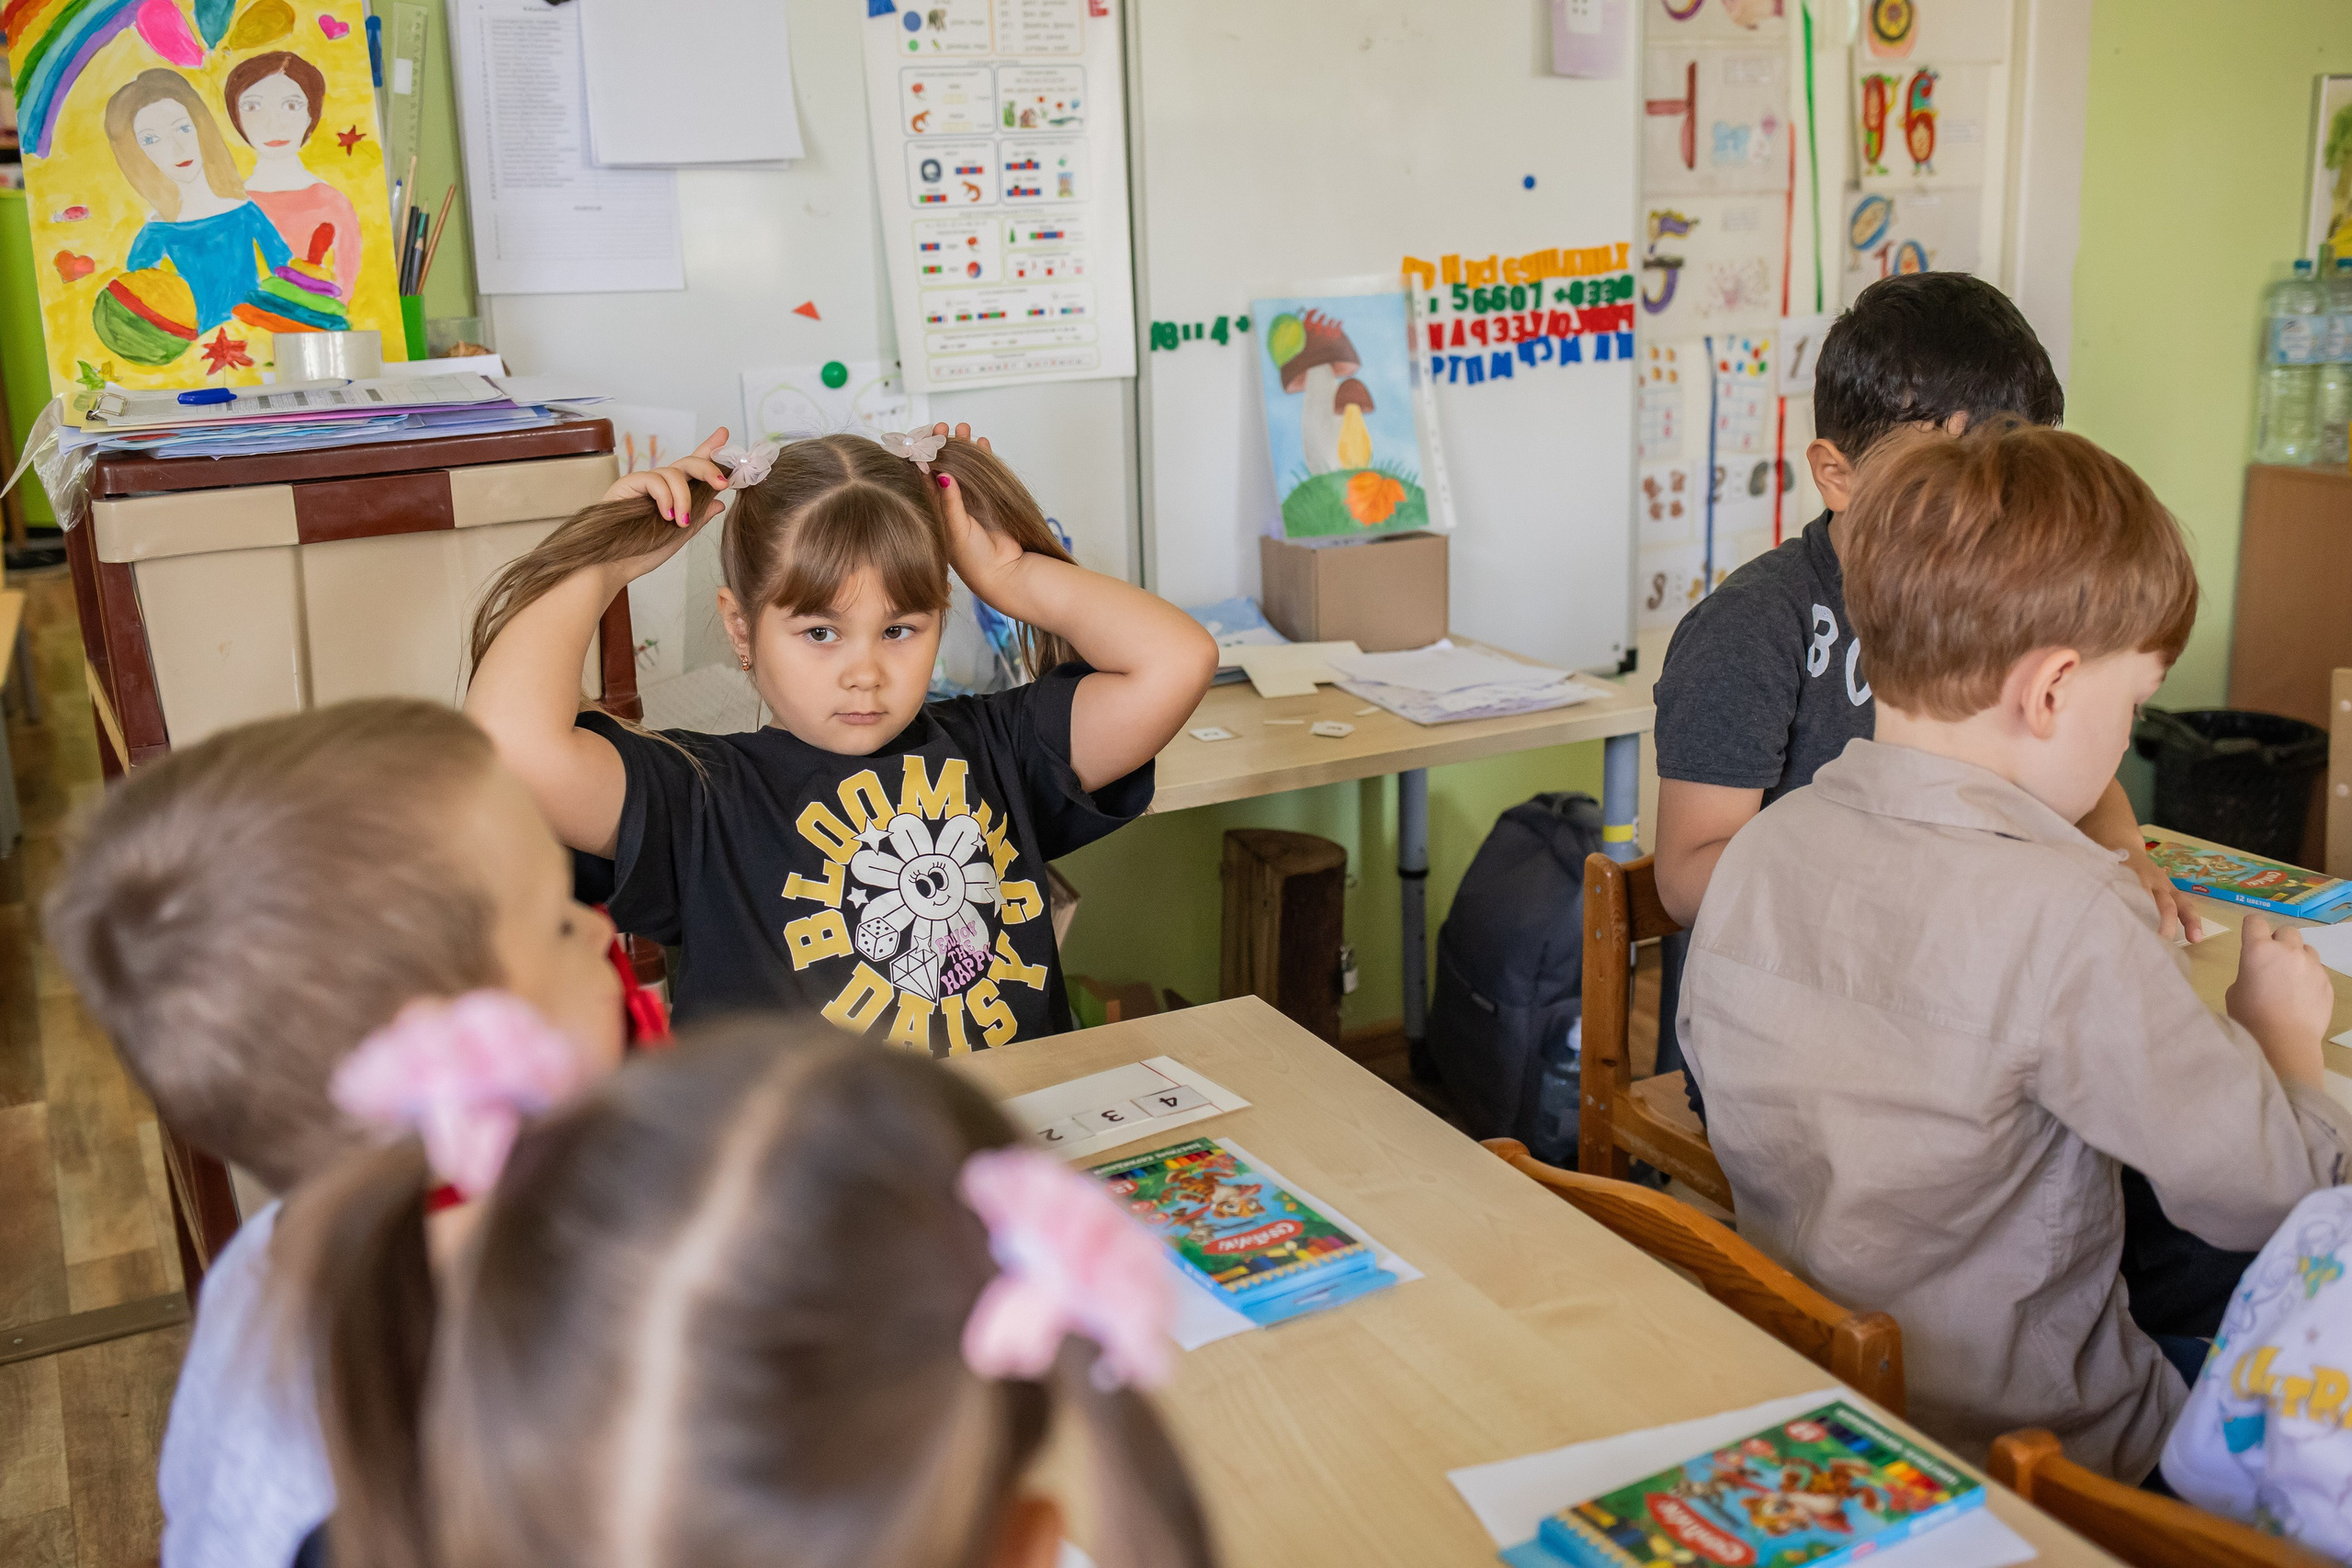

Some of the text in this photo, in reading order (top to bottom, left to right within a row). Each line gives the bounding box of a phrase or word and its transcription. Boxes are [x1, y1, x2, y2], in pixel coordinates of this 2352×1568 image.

[935, 920, 978, 955] ENJOY
[947, 939, 976, 964] THE
[940, 941, 994, 996] HAPPY
[820, 929, 1048, 1057] DAISY
[1101, 1110, 1125, 1122] 3
[1159, 1096, 1178, 1108] 4
